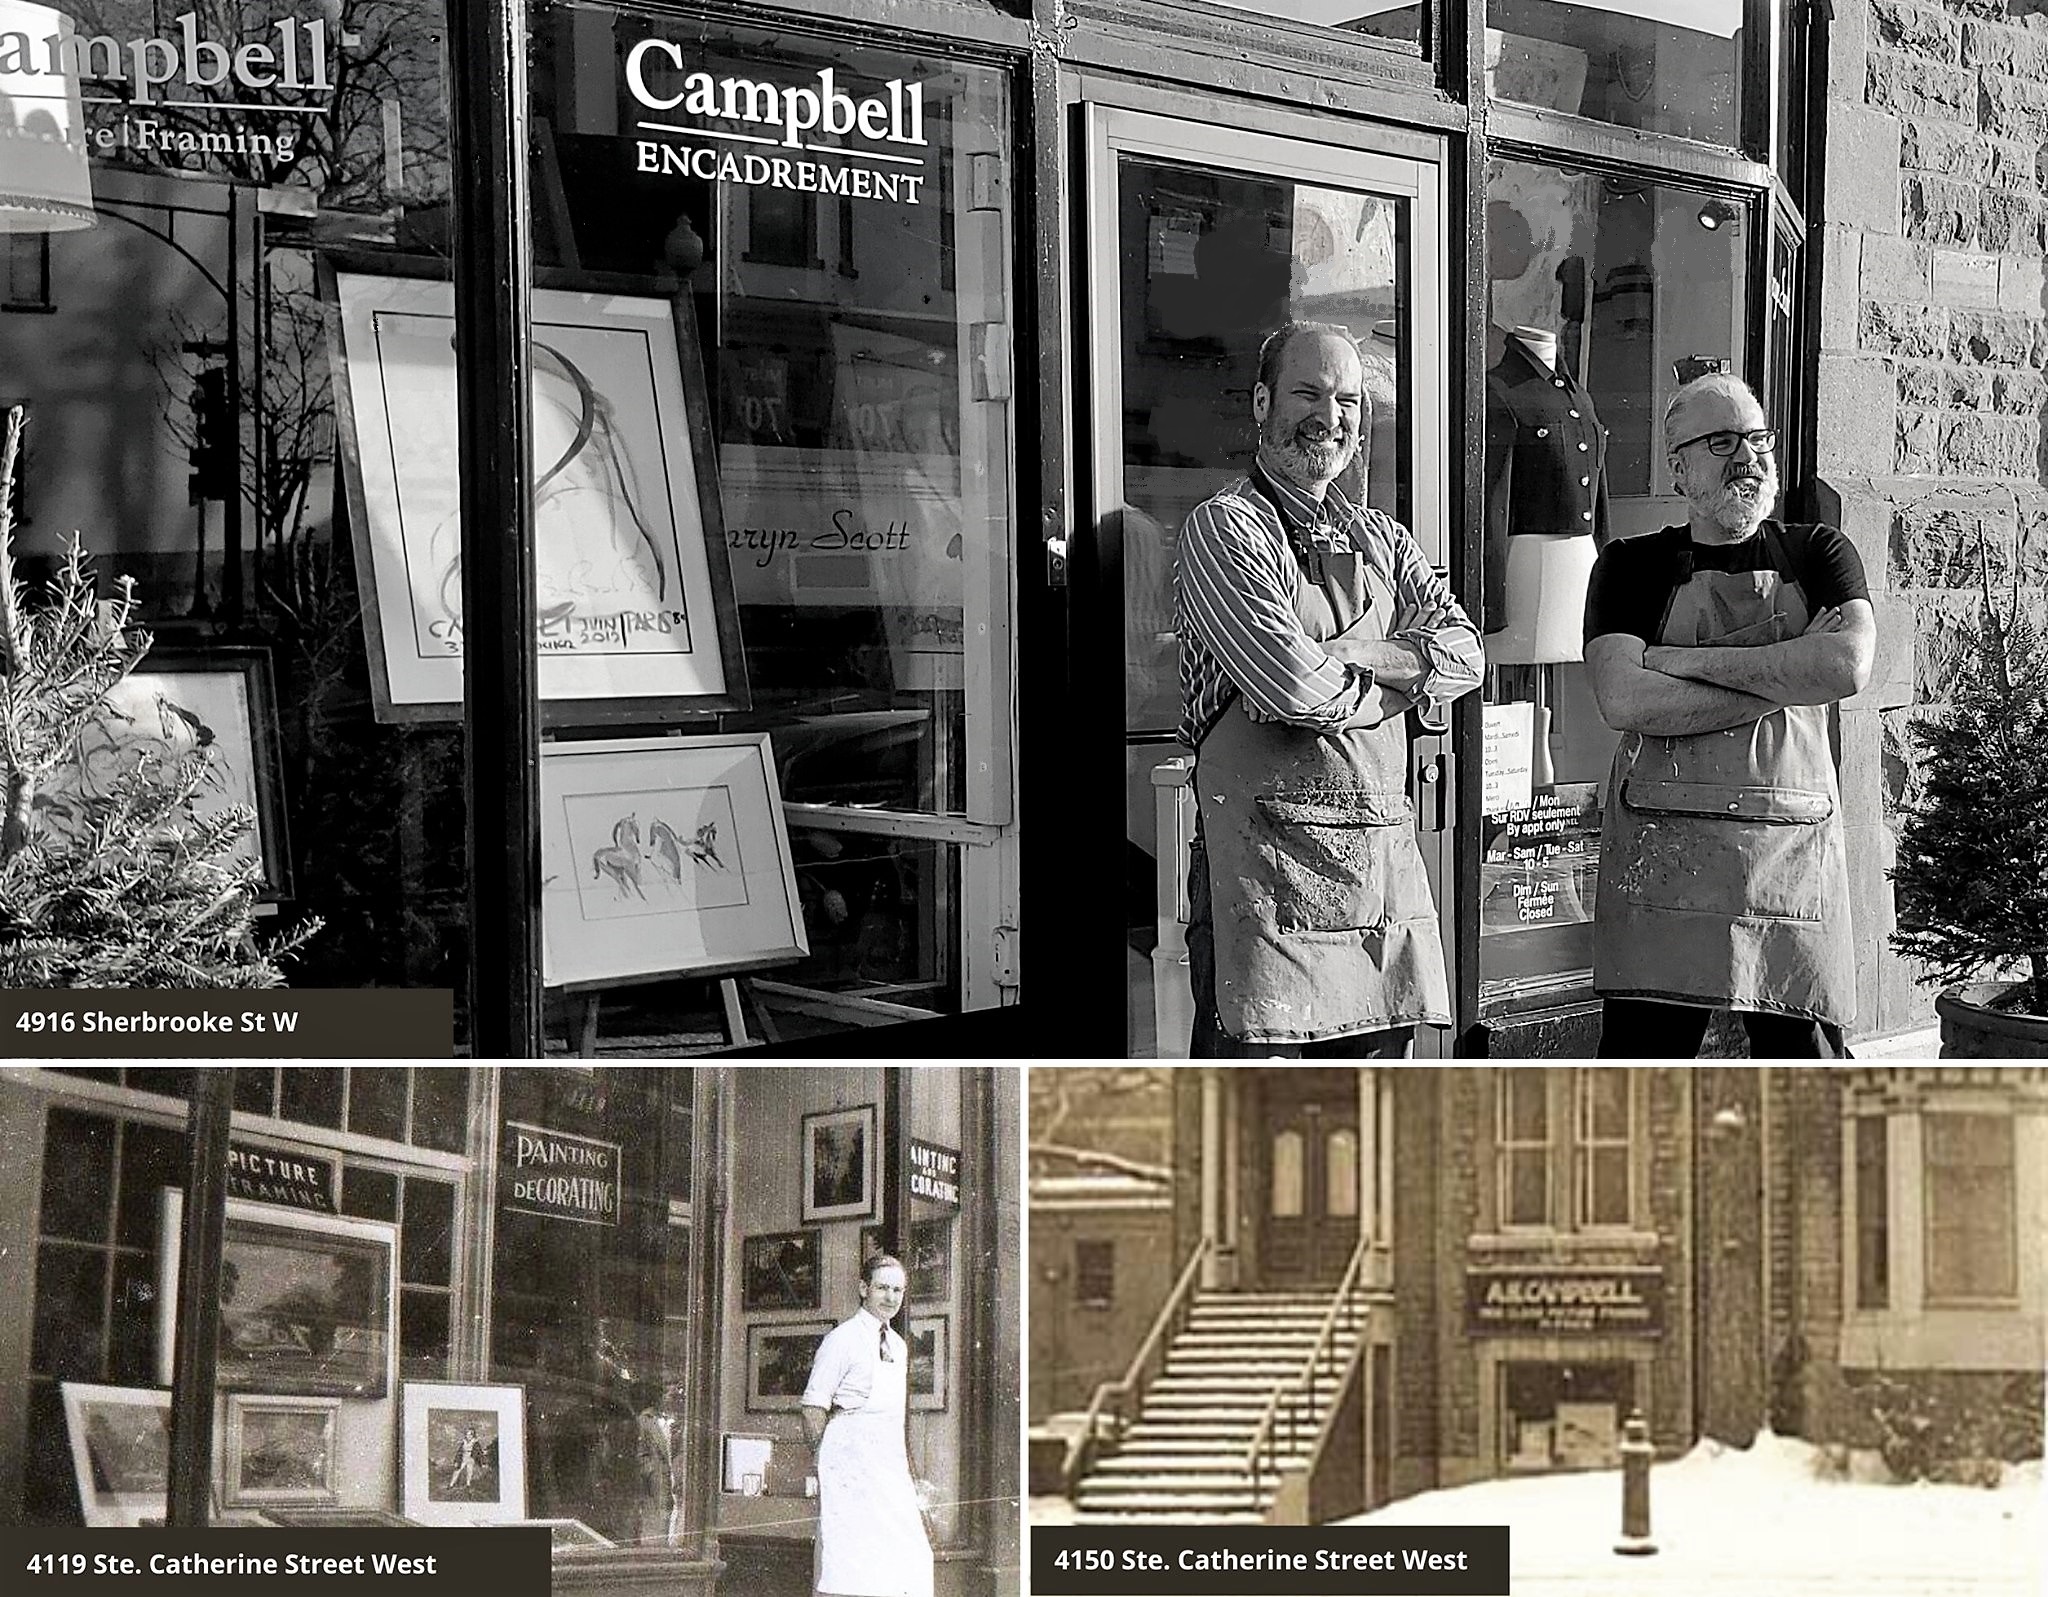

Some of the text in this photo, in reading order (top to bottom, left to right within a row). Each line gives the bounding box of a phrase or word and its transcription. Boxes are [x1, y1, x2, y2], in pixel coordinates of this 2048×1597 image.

[0, 11, 334, 106] ampbell
[625, 38, 929, 149] Campbell
[635, 140, 924, 205] ENCADREMENT
[810, 508, 912, 551] Scott
[1491, 812, 1508, 825] Sur
[1509, 809, 1531, 823] RDV
[1532, 804, 1581, 821] seulement
[1539, 794, 1560, 808] Mon
[1506, 818, 1566, 838] By appt only
[1486, 849, 1507, 863] Mar
[1513, 846, 1536, 860] Sam
[1544, 842, 1561, 857] Tue
[1567, 839, 1585, 852] Sat
[1523, 858, 1535, 871] 10
[1542, 857, 1550, 868] 5
[1513, 884, 1533, 898] Dim
[1540, 880, 1560, 893] Sun
[1517, 893, 1555, 909] Fermée
[1518, 906, 1554, 921] Closed
[515, 1135, 609, 1169] PAINTING
[909, 1145, 957, 1175] AINTING
[227, 1149, 319, 1187] PICTURE
[513, 1176, 614, 1215] DECORATING
